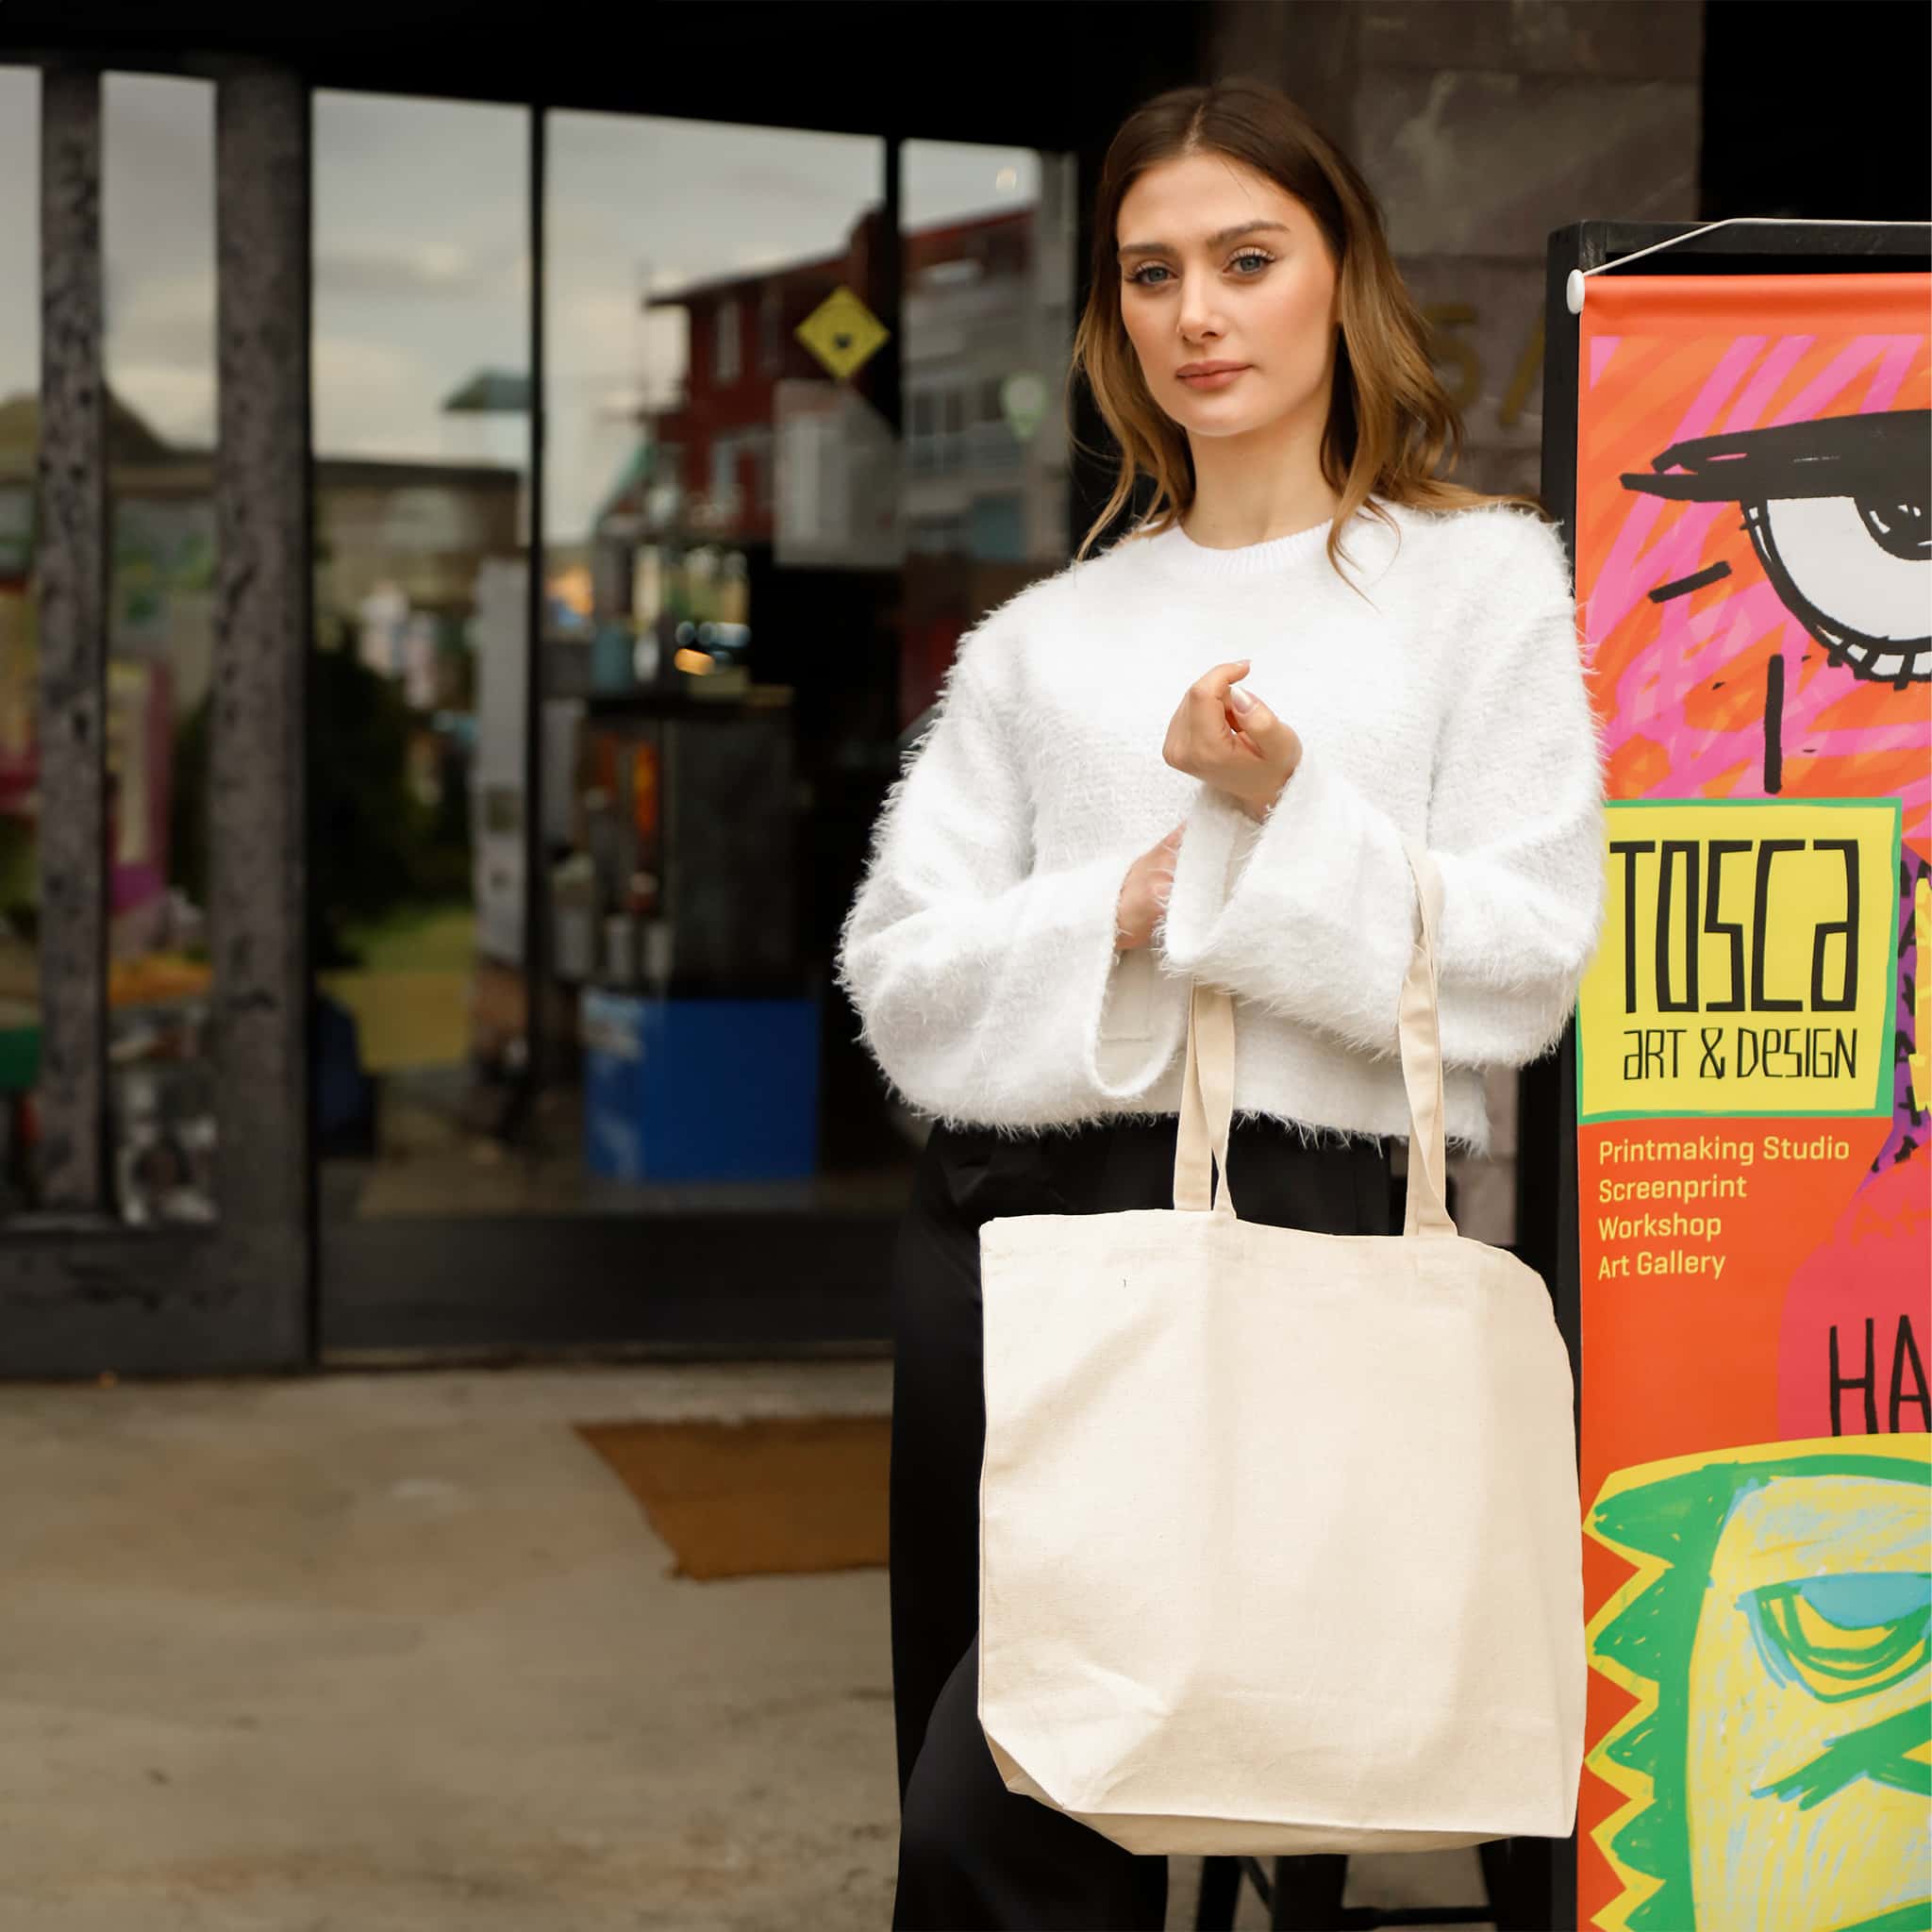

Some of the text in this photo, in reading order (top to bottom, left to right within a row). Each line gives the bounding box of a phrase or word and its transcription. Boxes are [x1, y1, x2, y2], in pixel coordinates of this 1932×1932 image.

[1699, 1026, 1725, 1080] &
[1599, 1135, 1850, 1166] Printmaking Studio
[1598, 1174, 1748, 1205] Screenprint
[1597, 1211, 1722, 1242] Workshop
[1597, 1249, 1726, 1280] Art Gallery
